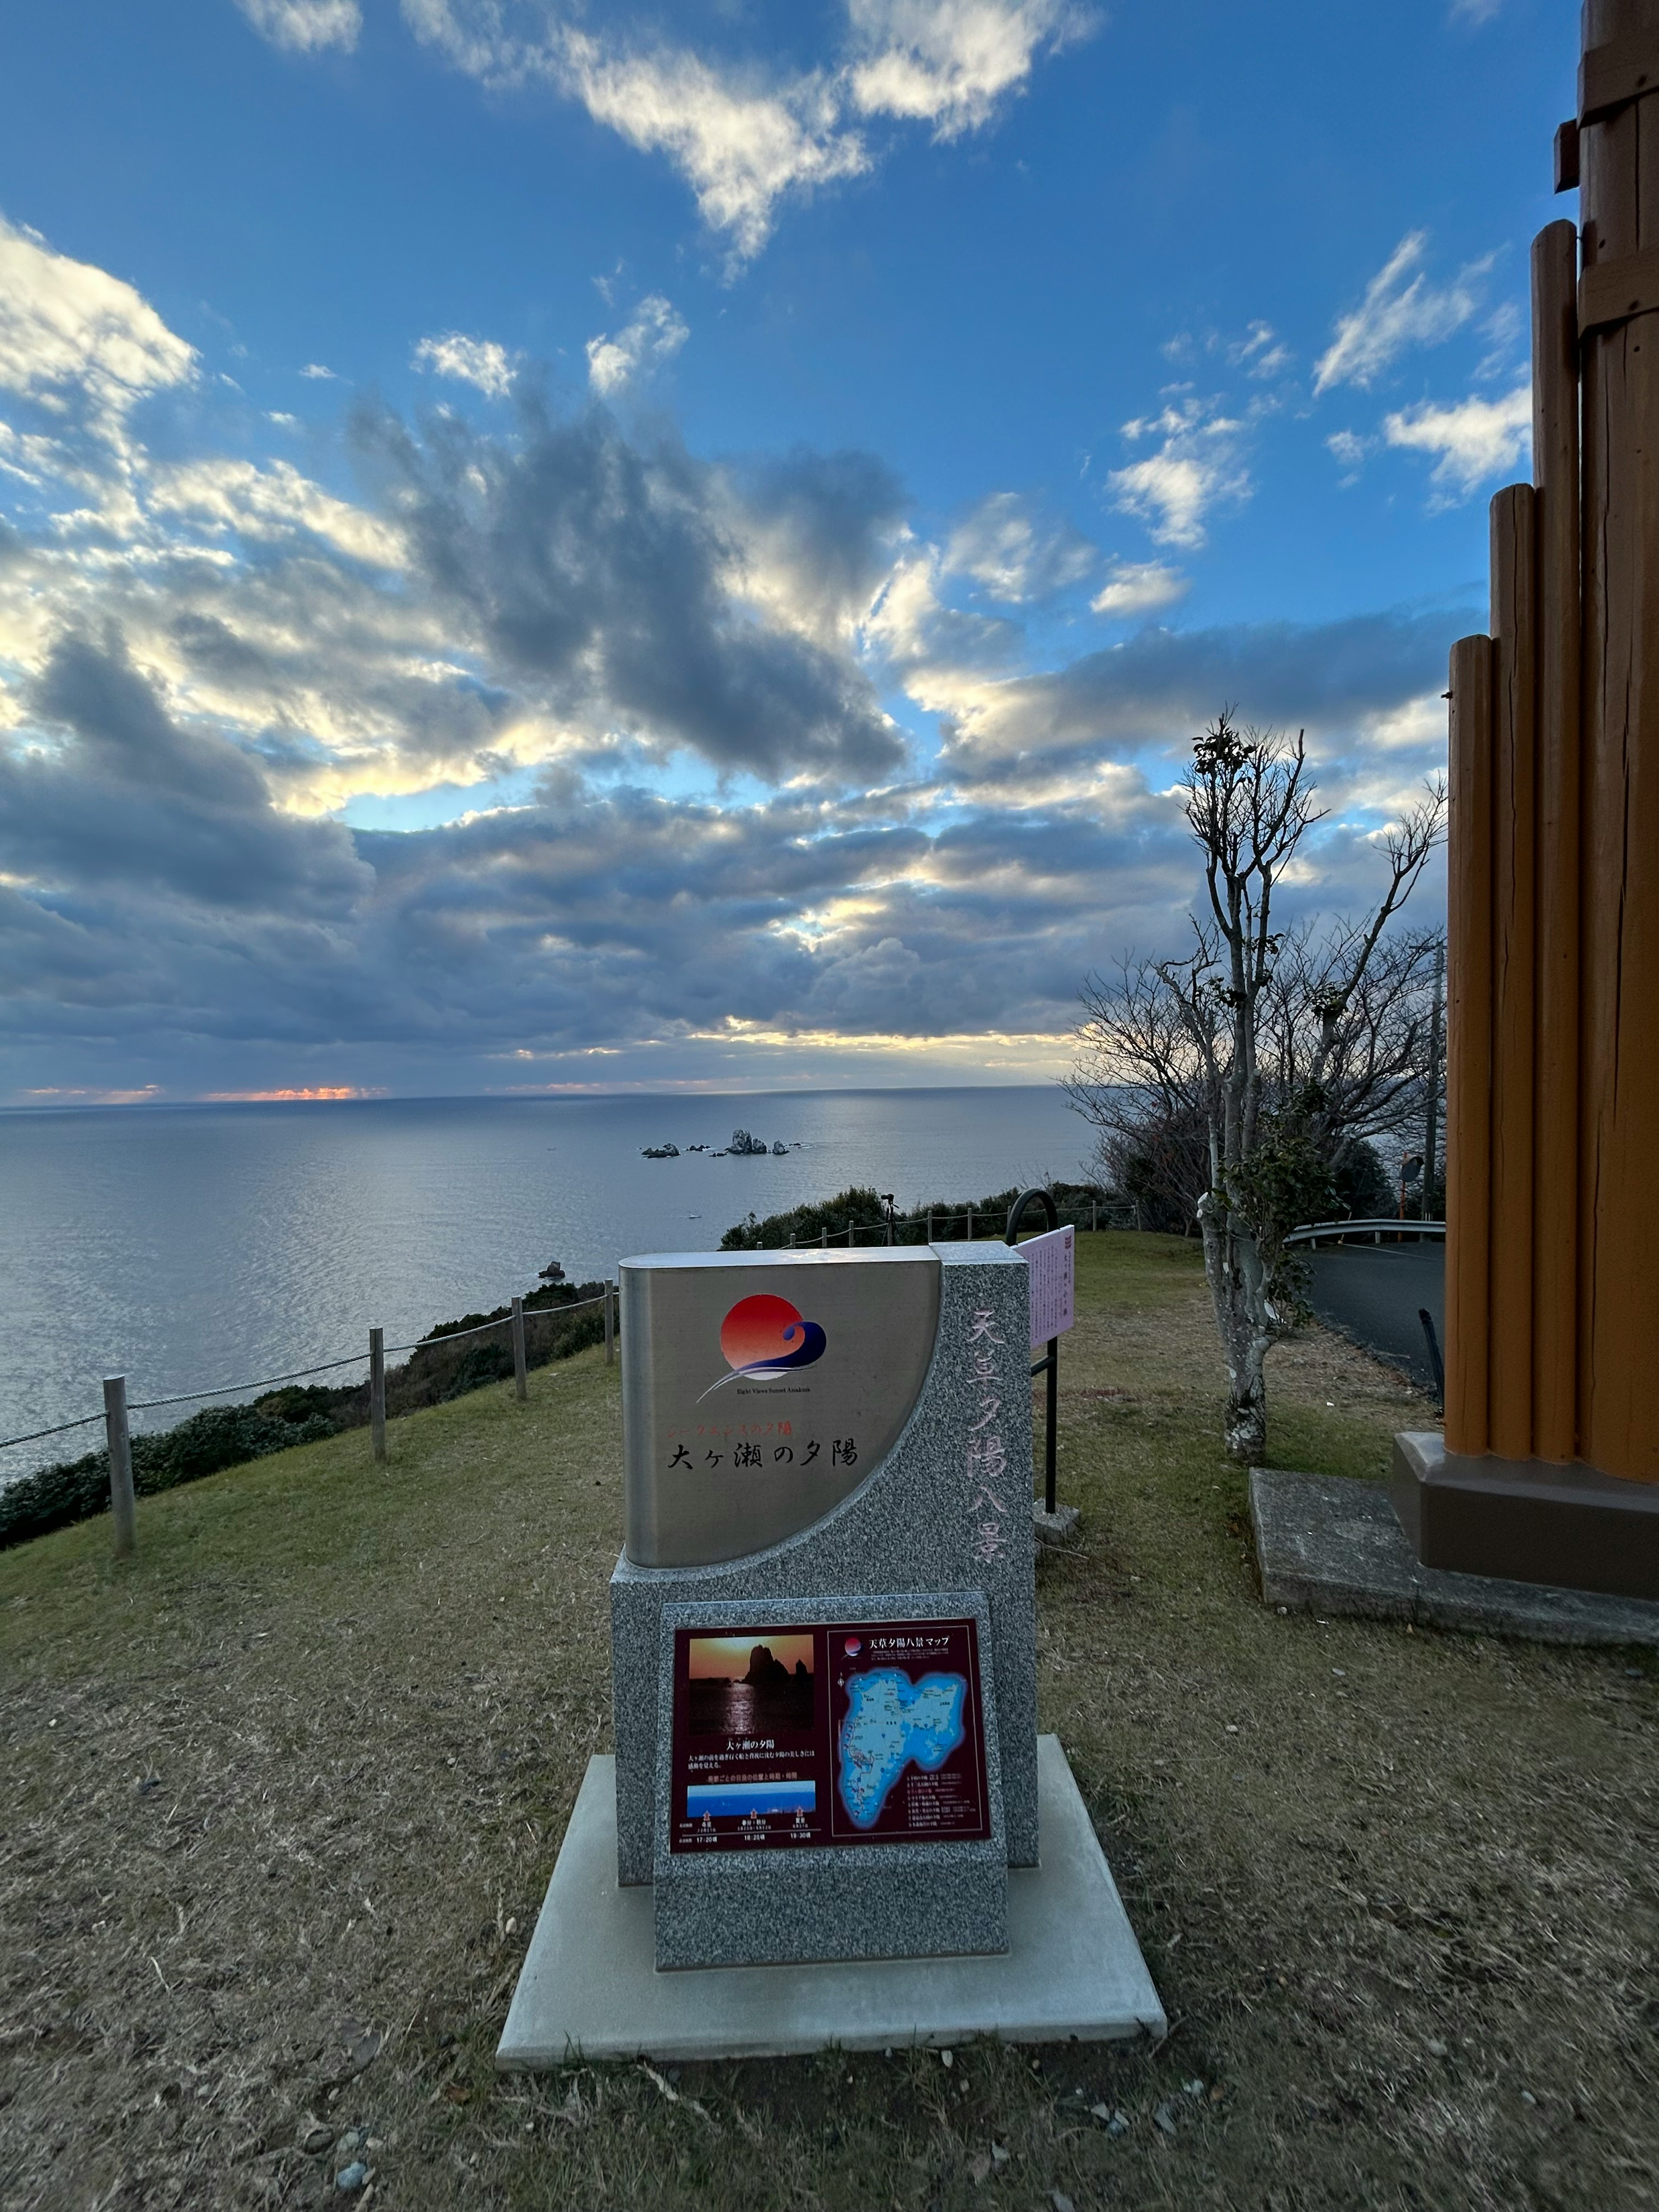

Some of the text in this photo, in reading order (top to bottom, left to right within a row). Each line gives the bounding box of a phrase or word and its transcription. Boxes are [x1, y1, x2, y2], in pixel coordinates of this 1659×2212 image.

[966, 1309, 1008, 1563] 天草夕陽八景
